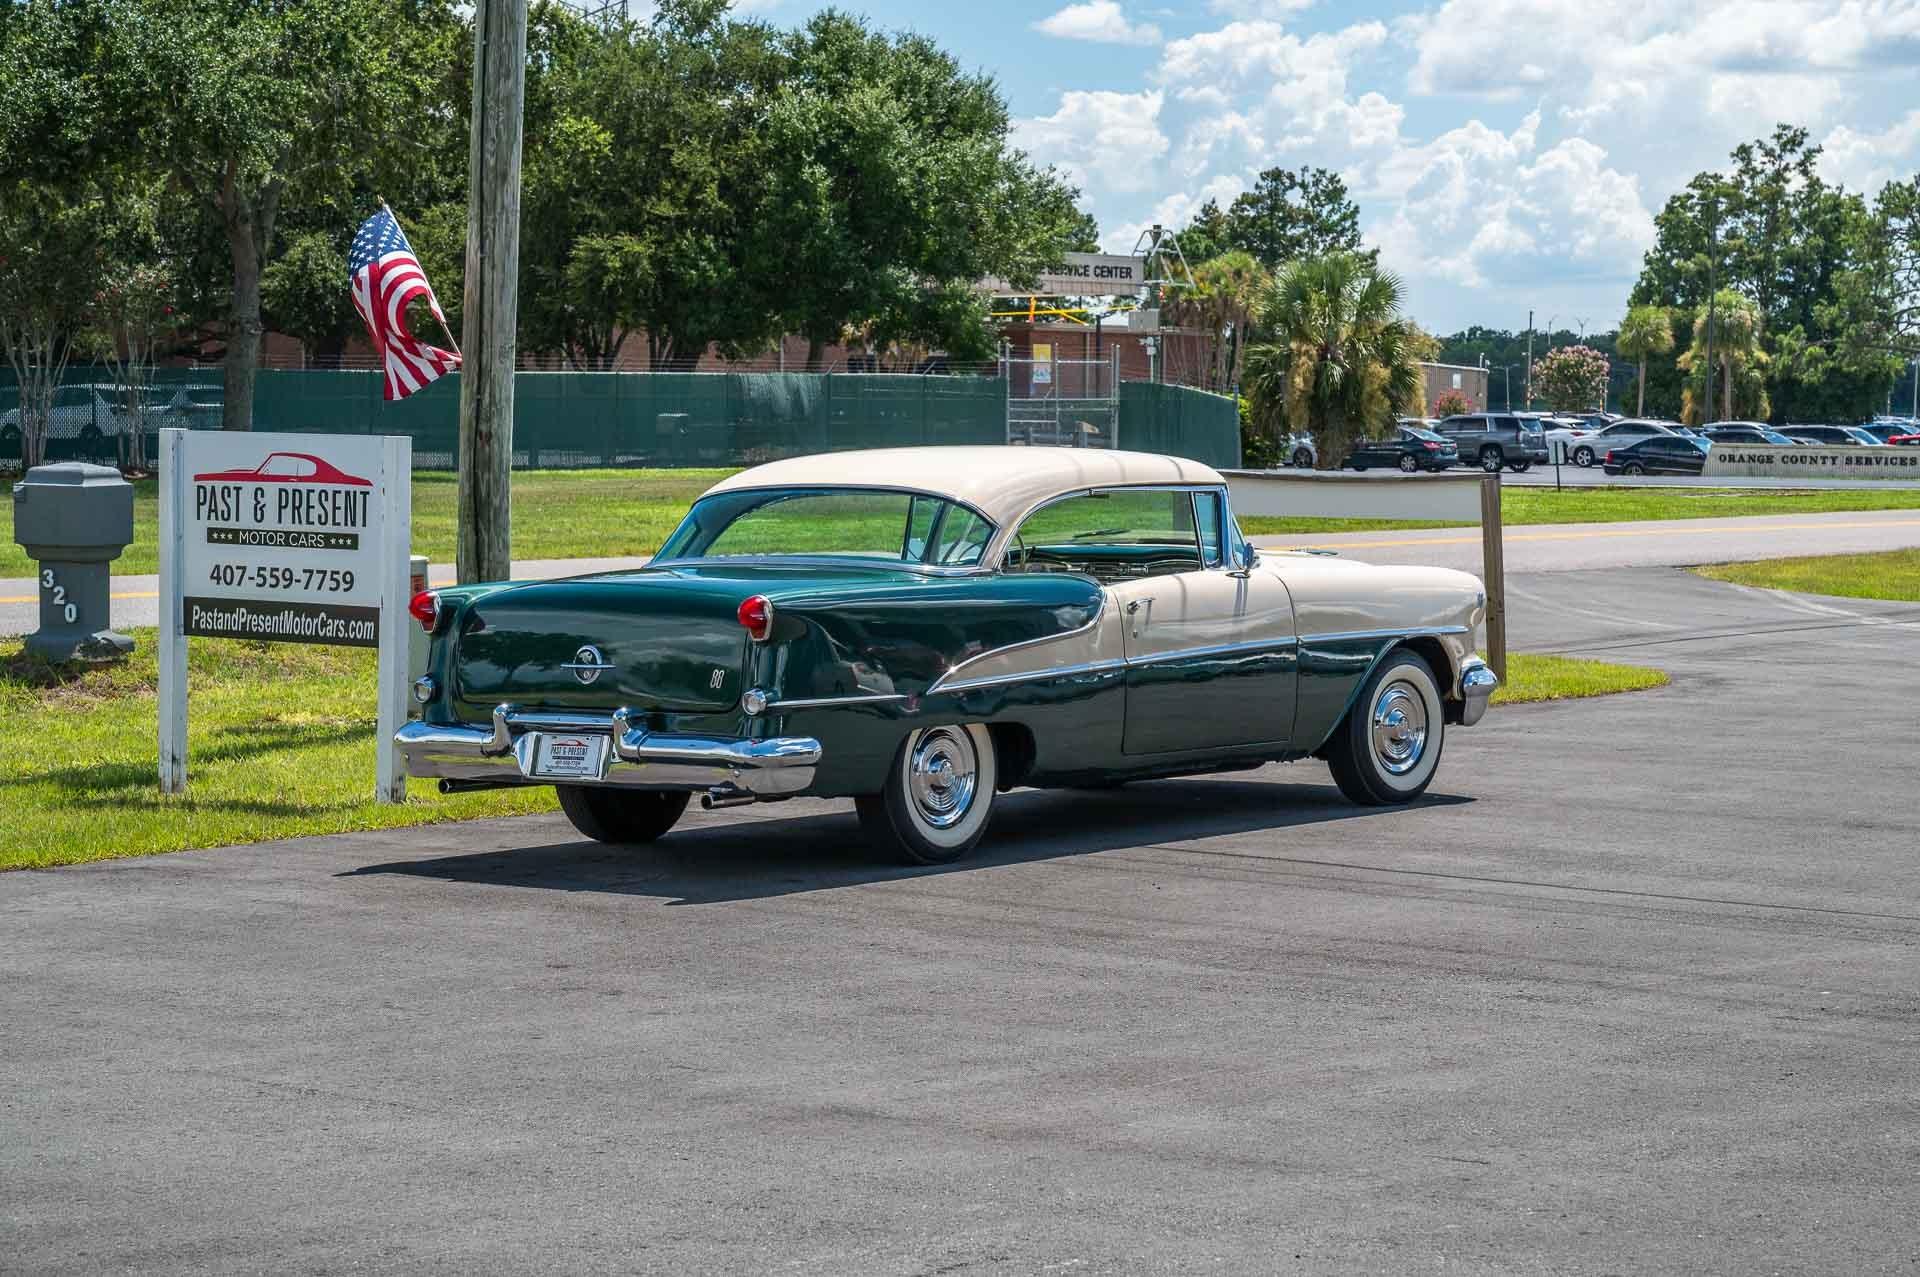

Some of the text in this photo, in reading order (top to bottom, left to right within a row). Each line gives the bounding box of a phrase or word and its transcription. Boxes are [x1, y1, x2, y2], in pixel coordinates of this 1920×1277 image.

[1093, 265, 1133, 279] CENTER
[1718, 454, 1918, 467] ORANGE COUNTY SERVICES
[196, 484, 370, 528] PAST & PRESENT
[239, 530, 325, 548] MOTOR CARS
[209, 563, 355, 593] 407-559-7759
[191, 604, 375, 641] PastandPresentMotorCars.com
[710, 668, 725, 689] 88
